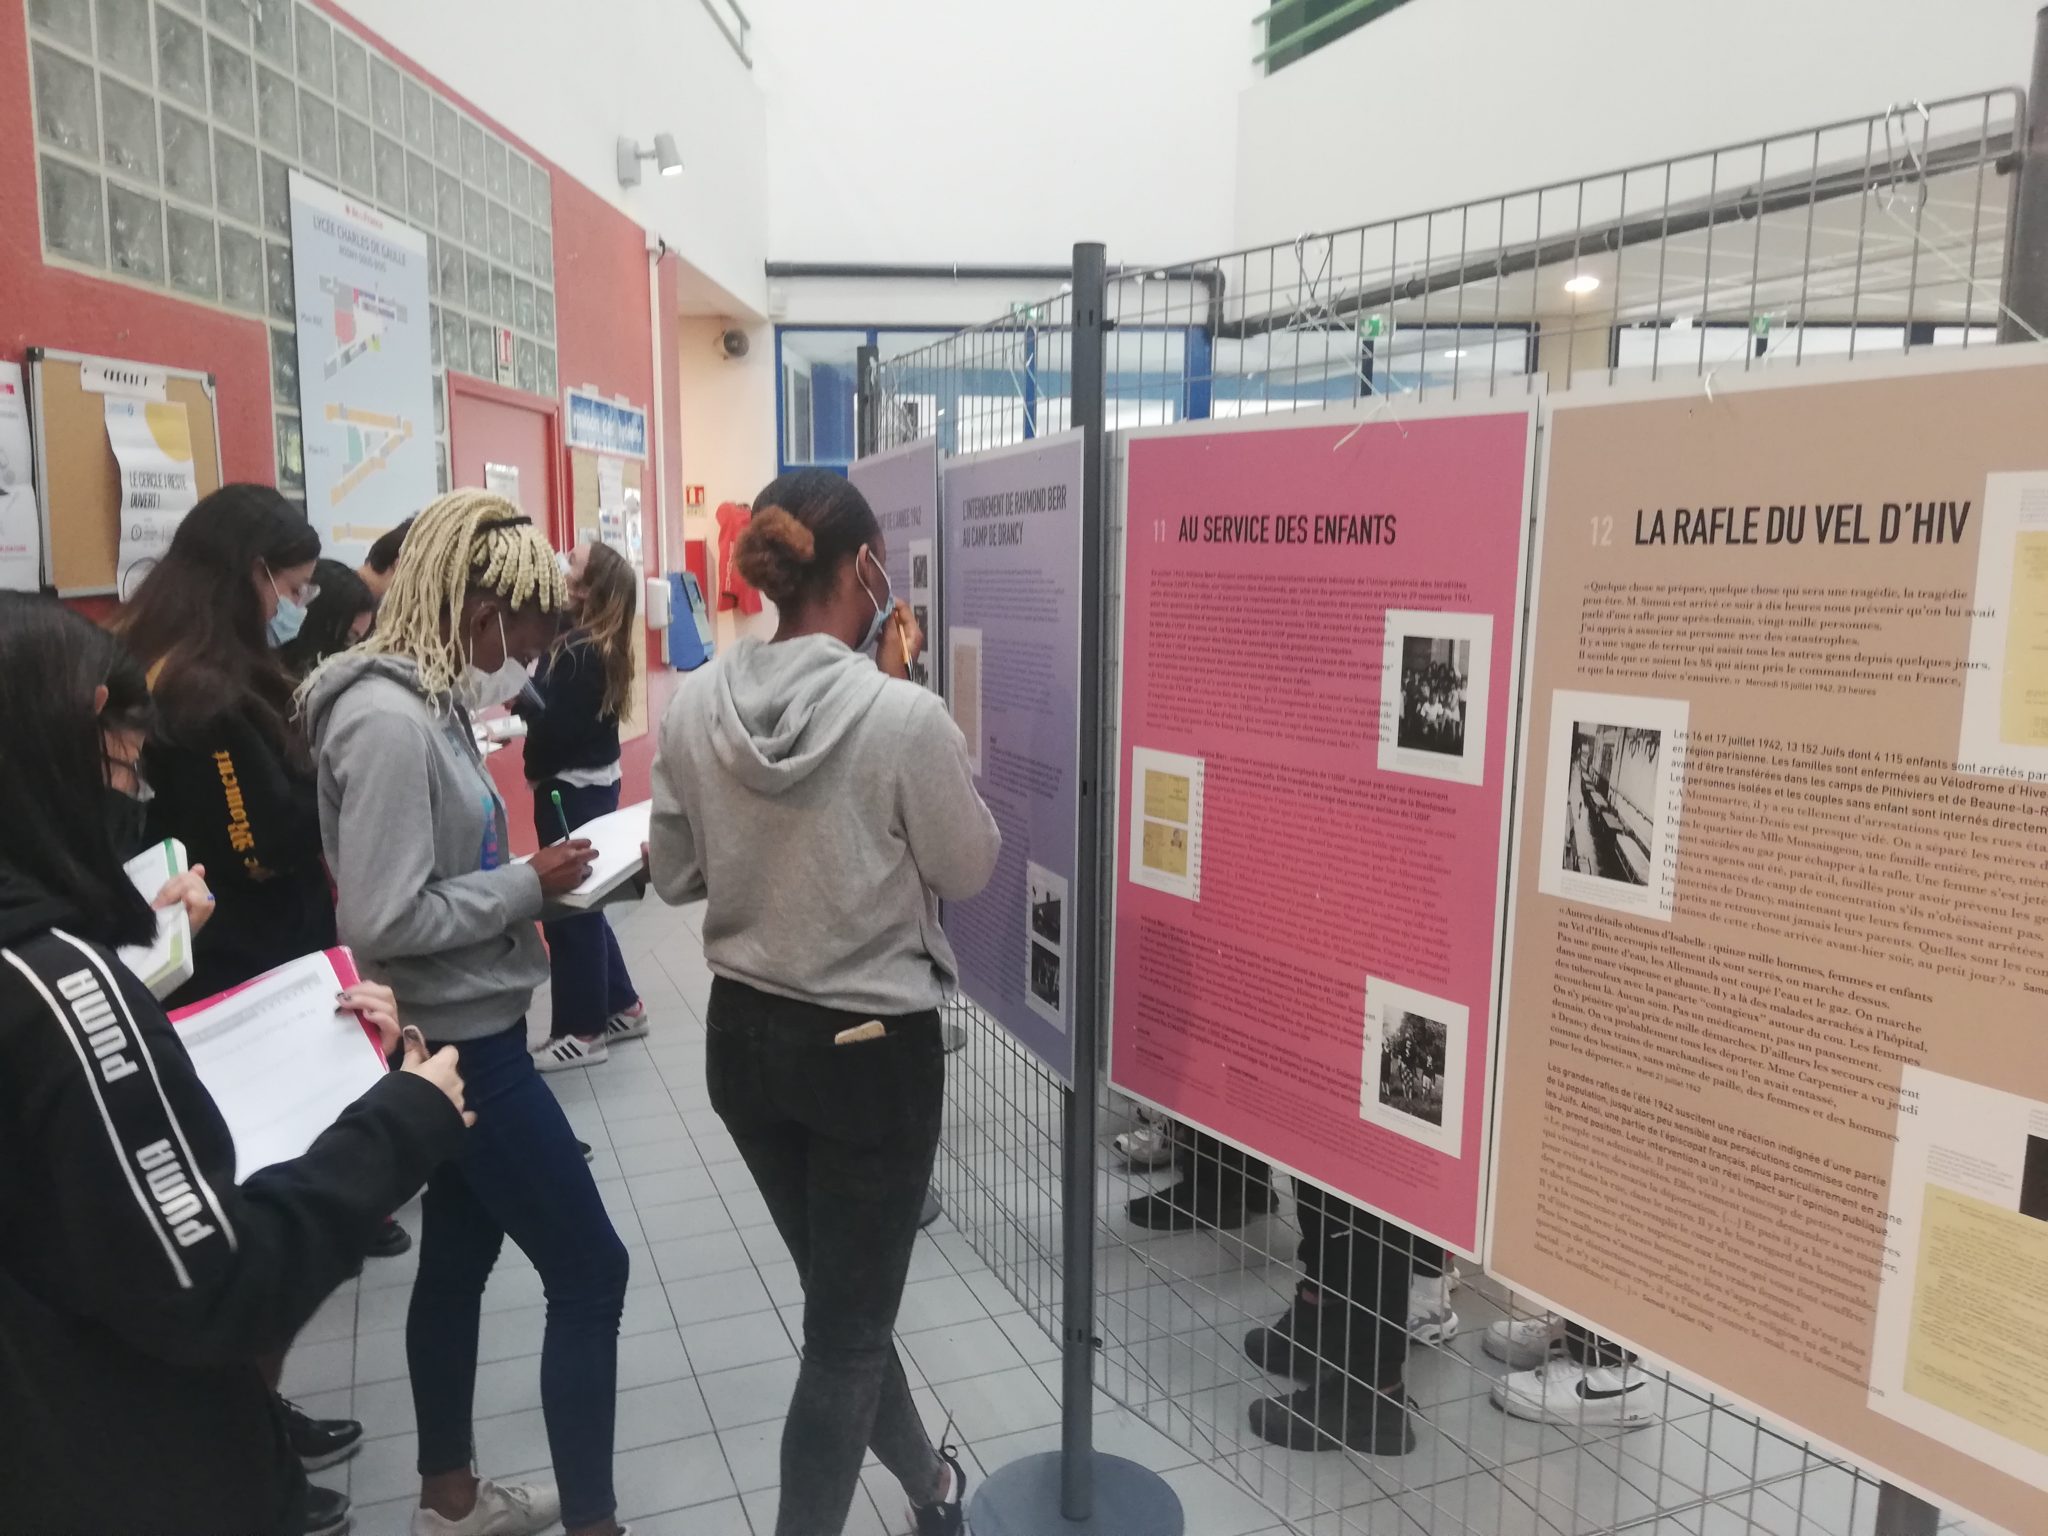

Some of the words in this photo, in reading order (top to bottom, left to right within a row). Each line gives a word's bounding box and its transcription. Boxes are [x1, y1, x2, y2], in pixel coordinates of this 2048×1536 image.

[337, 223, 369, 250] CHARLES
[381, 243, 406, 266] GAULLE
[130, 492, 157, 509] OUVERT
[963, 492, 1004, 520] L'INTERNEMENT
[1006, 492, 1014, 516] DE
[1015, 488, 1046, 515] RAYMOND
[1048, 484, 1067, 511] BERR
[963, 527, 971, 548] AU
[972, 524, 988, 547] CAMP
[989, 523, 996, 546] DE
[998, 521, 1023, 546] DRANCY
[1154, 519, 1166, 543] 11
[1178, 515, 1199, 542] AU
[1203, 514, 1270, 544] SERVICE
[1275, 514, 1308, 544] DES
[1314, 514, 1396, 545] ENFANTS
[1590, 514, 1614, 546] 12
[1635, 509, 1666, 545] LA
[1673, 506, 1761, 545] RAFLE
[1766, 504, 1806, 545] DU
[1816, 504, 1870, 544] VEL
[1880, 501, 1971, 544] D'HIV
[1672, 744, 1683, 752] en
[1685, 744, 1714, 757] région
[1772, 754, 1789, 765] Les
[1792, 757, 1832, 770] familles
[1836, 764, 1857, 773] sont
[1861, 767, 1920, 781] enfermées
[1923, 775, 1937, 783] au
[1940, 775, 2004, 791] Vélodrome
[1674, 728, 1690, 739] Les
[1692, 730, 1702, 740] 16
[1704, 732, 1712, 742] et
[1717, 733, 1726, 743] 17
[1728, 735, 1755, 747] juillet
[1786, 742, 1797, 752] 13
[1802, 744, 1817, 754] 152
[1820, 746, 1845, 757] Juifs
[1848, 749, 1871, 760] dont
[1886, 753, 1902, 764] 115
[1906, 757, 1947, 769] enfants
[1951, 763, 1975, 772] sont
[1980, 766, 2024, 777] arrêtés
[2028, 771, 2047, 781] par
[1670, 771, 1685, 782] Les
[1688, 776, 1735, 788] personnes
[1738, 780, 1771, 793] isolées
[1774, 785, 1783, 795] et
[1787, 786, 1801, 797] les
[1804, 791, 1843, 803] couples
[1846, 797, 1871, 806] sans
[1874, 800, 1908, 811] enfant
[1912, 806, 1937, 816] sont
[1940, 808, 1988, 823] internés
[1671, 759, 1694, 768] avant
[1726, 764, 1781, 780] transférées
[1784, 771, 1808, 783] dans
[1810, 775, 1825, 785] les
[1828, 779, 1863, 792] camps
[1864, 782, 1878, 792] de
[1882, 784, 1934, 800] Pithiviers
[1938, 792, 1948, 802] et
[1952, 794, 1966, 804] de
[56, 968, 139, 1084] PUMA
[136, 1138, 216, 1247] PUMA
